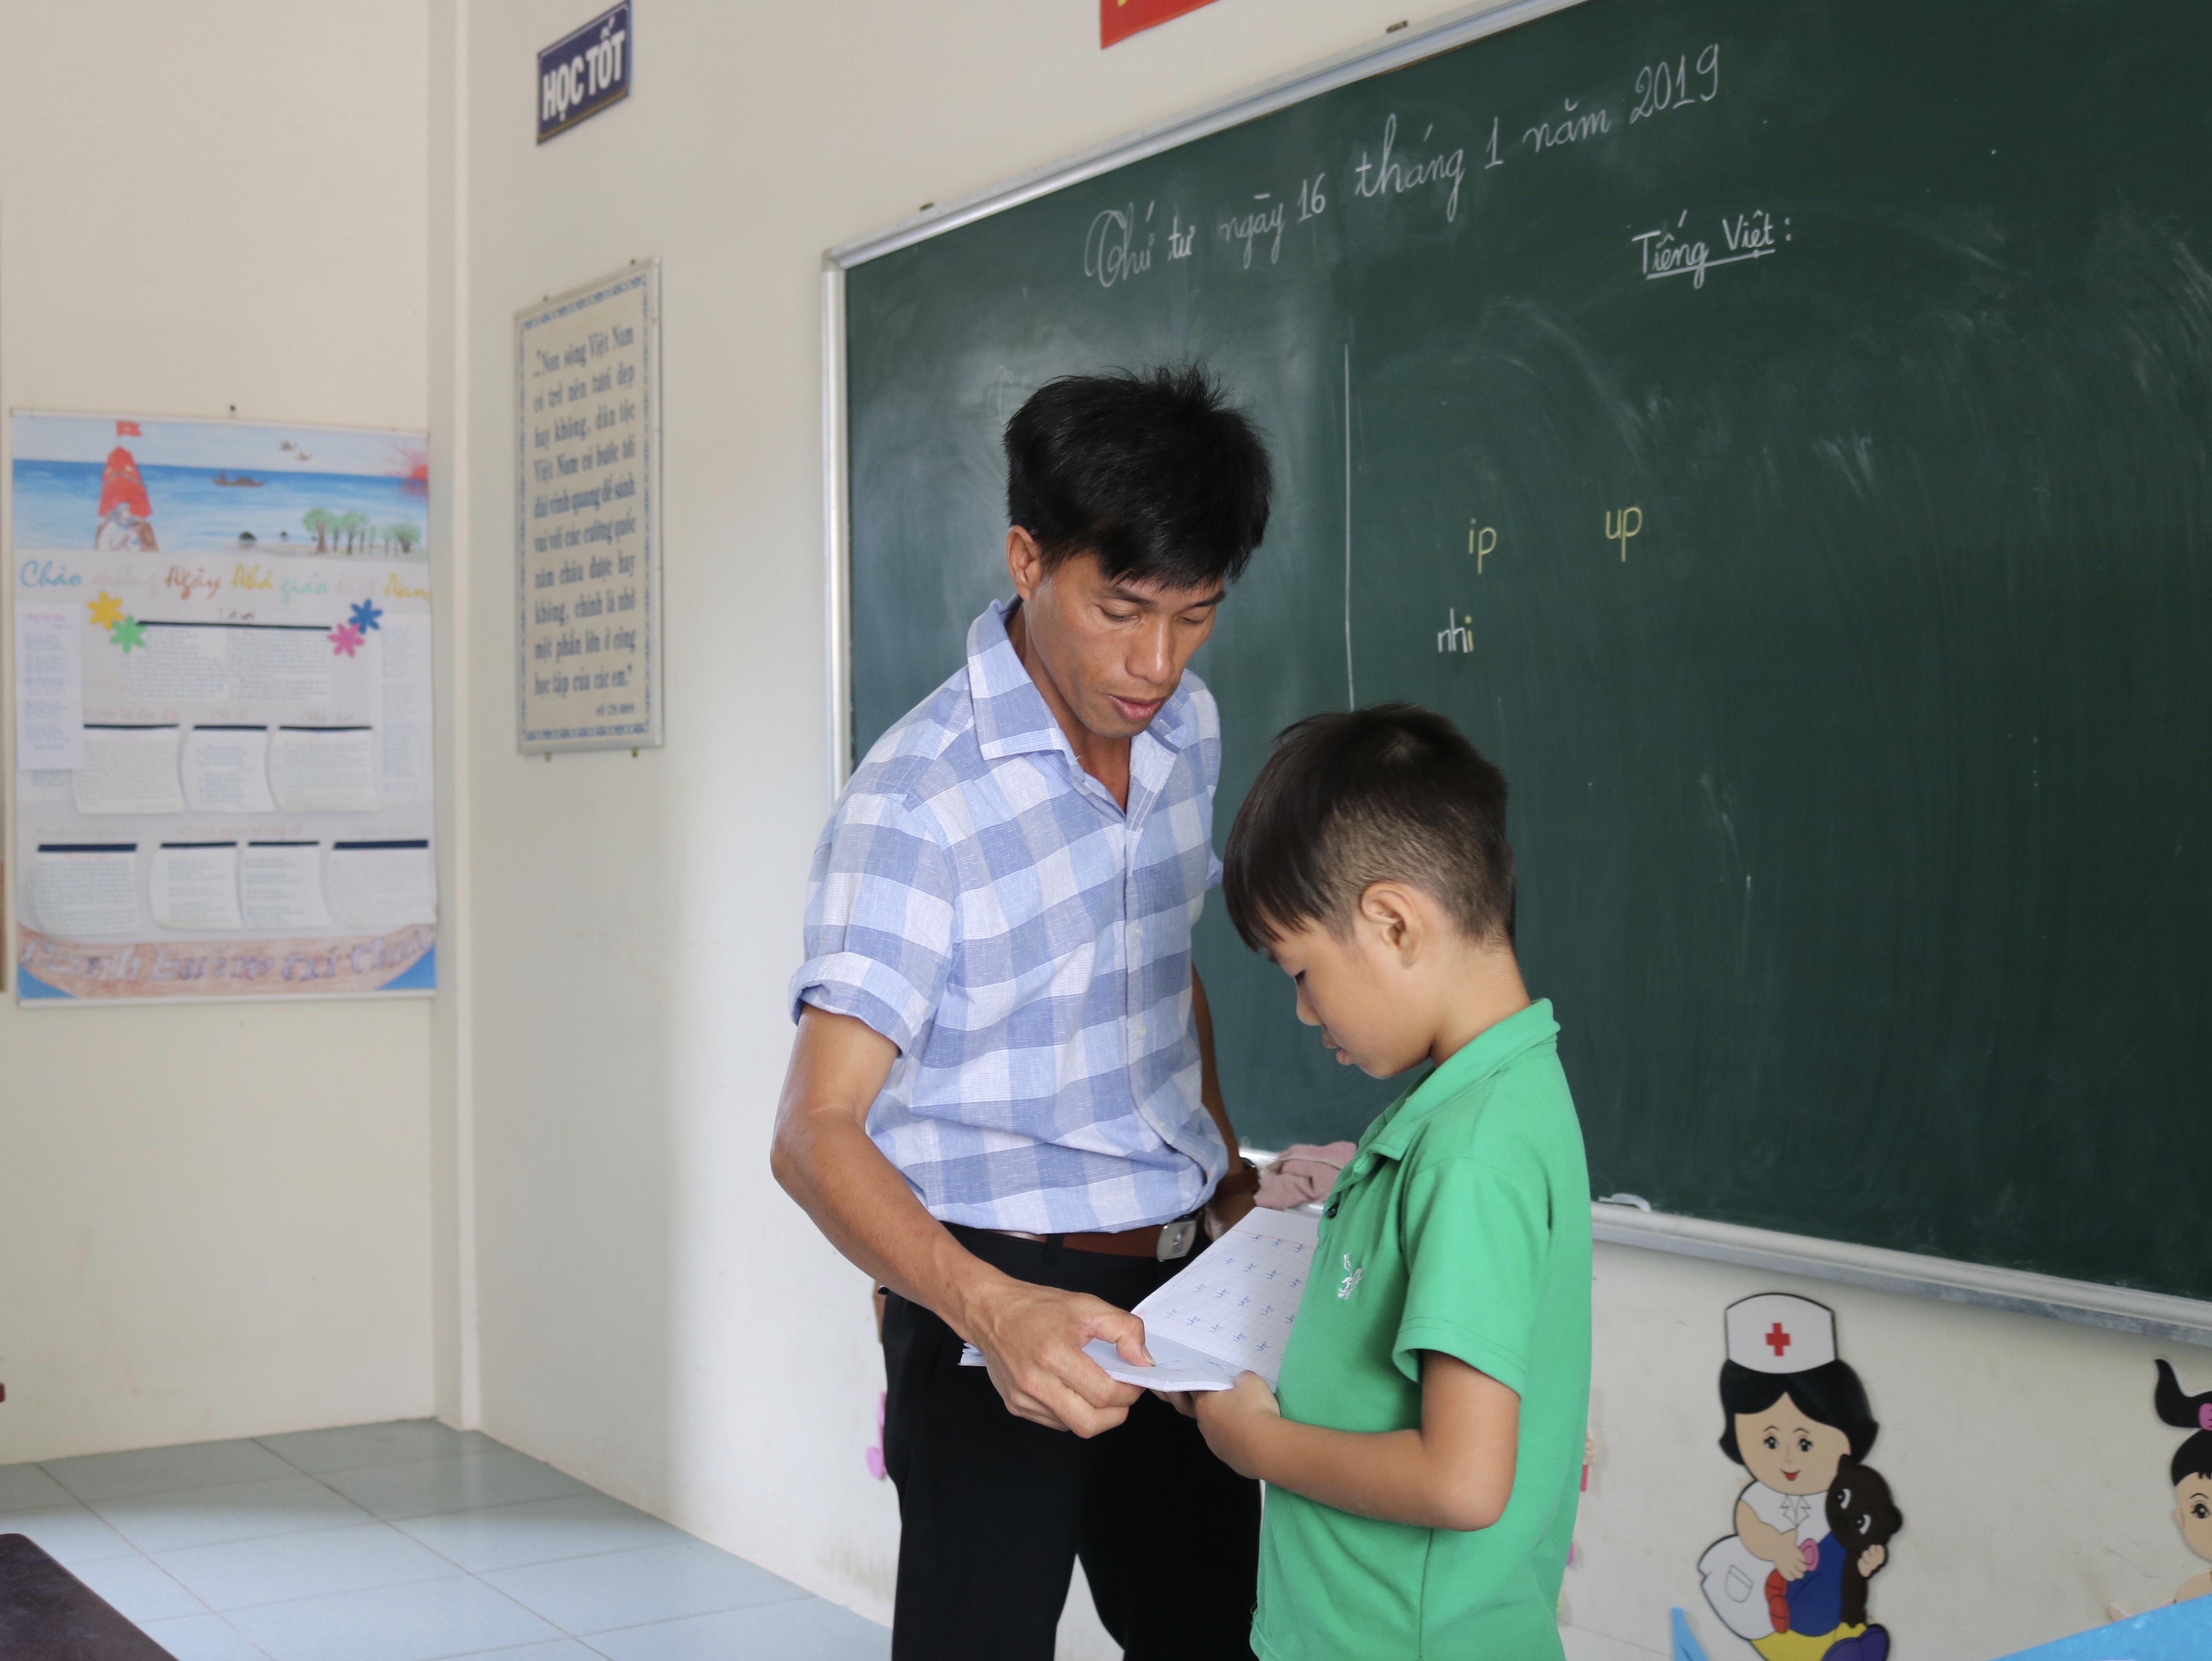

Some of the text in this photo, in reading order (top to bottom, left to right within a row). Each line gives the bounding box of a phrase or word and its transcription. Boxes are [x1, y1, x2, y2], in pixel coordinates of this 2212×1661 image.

[542, 15, 626, 122] HỌC TỐT
[1167, 215, 1195, 261] tư
[1297, 172, 1326, 223] 16
[1354, 113, 1466, 223] tháng
[1484, 116, 1504, 169] 1
[1522, 98, 1611, 153] năm
[1630, 43, 1720, 124] 2019
[1631, 209, 1710, 289] Tiếng
[1469, 518, 1497, 575] ip
[1605, 506, 1643, 562] up
[20, 560, 81, 588] Chào
[164, 564, 222, 601] Ngày
